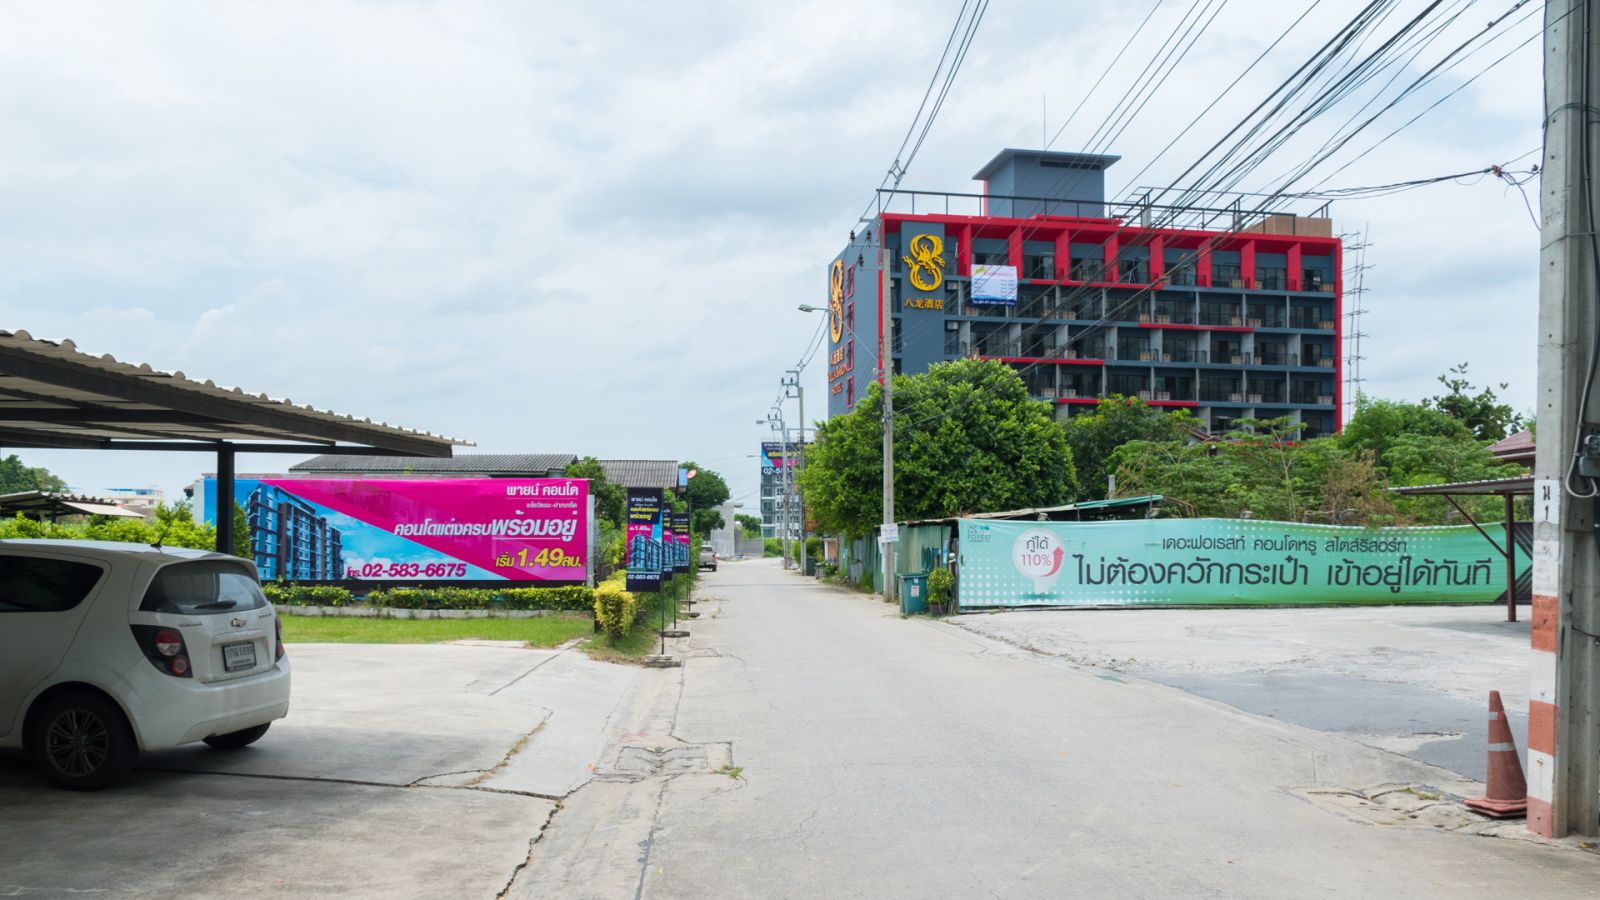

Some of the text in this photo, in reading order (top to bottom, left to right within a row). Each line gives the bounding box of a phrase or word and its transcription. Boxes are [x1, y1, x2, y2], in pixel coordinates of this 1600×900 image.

[507, 481, 579, 496] พายน์ คอนโด
[1026, 535, 1050, 553] กู้ได้
[1162, 534, 1246, 550] เดอะฟอเรสท์
[1253, 534, 1318, 556] คอนโดหรู
[1021, 553, 1052, 566] 110%
[1072, 552, 1492, 594] ไม่ต้องควักกระเป๋า เข้าอยู่ได้ทันที
